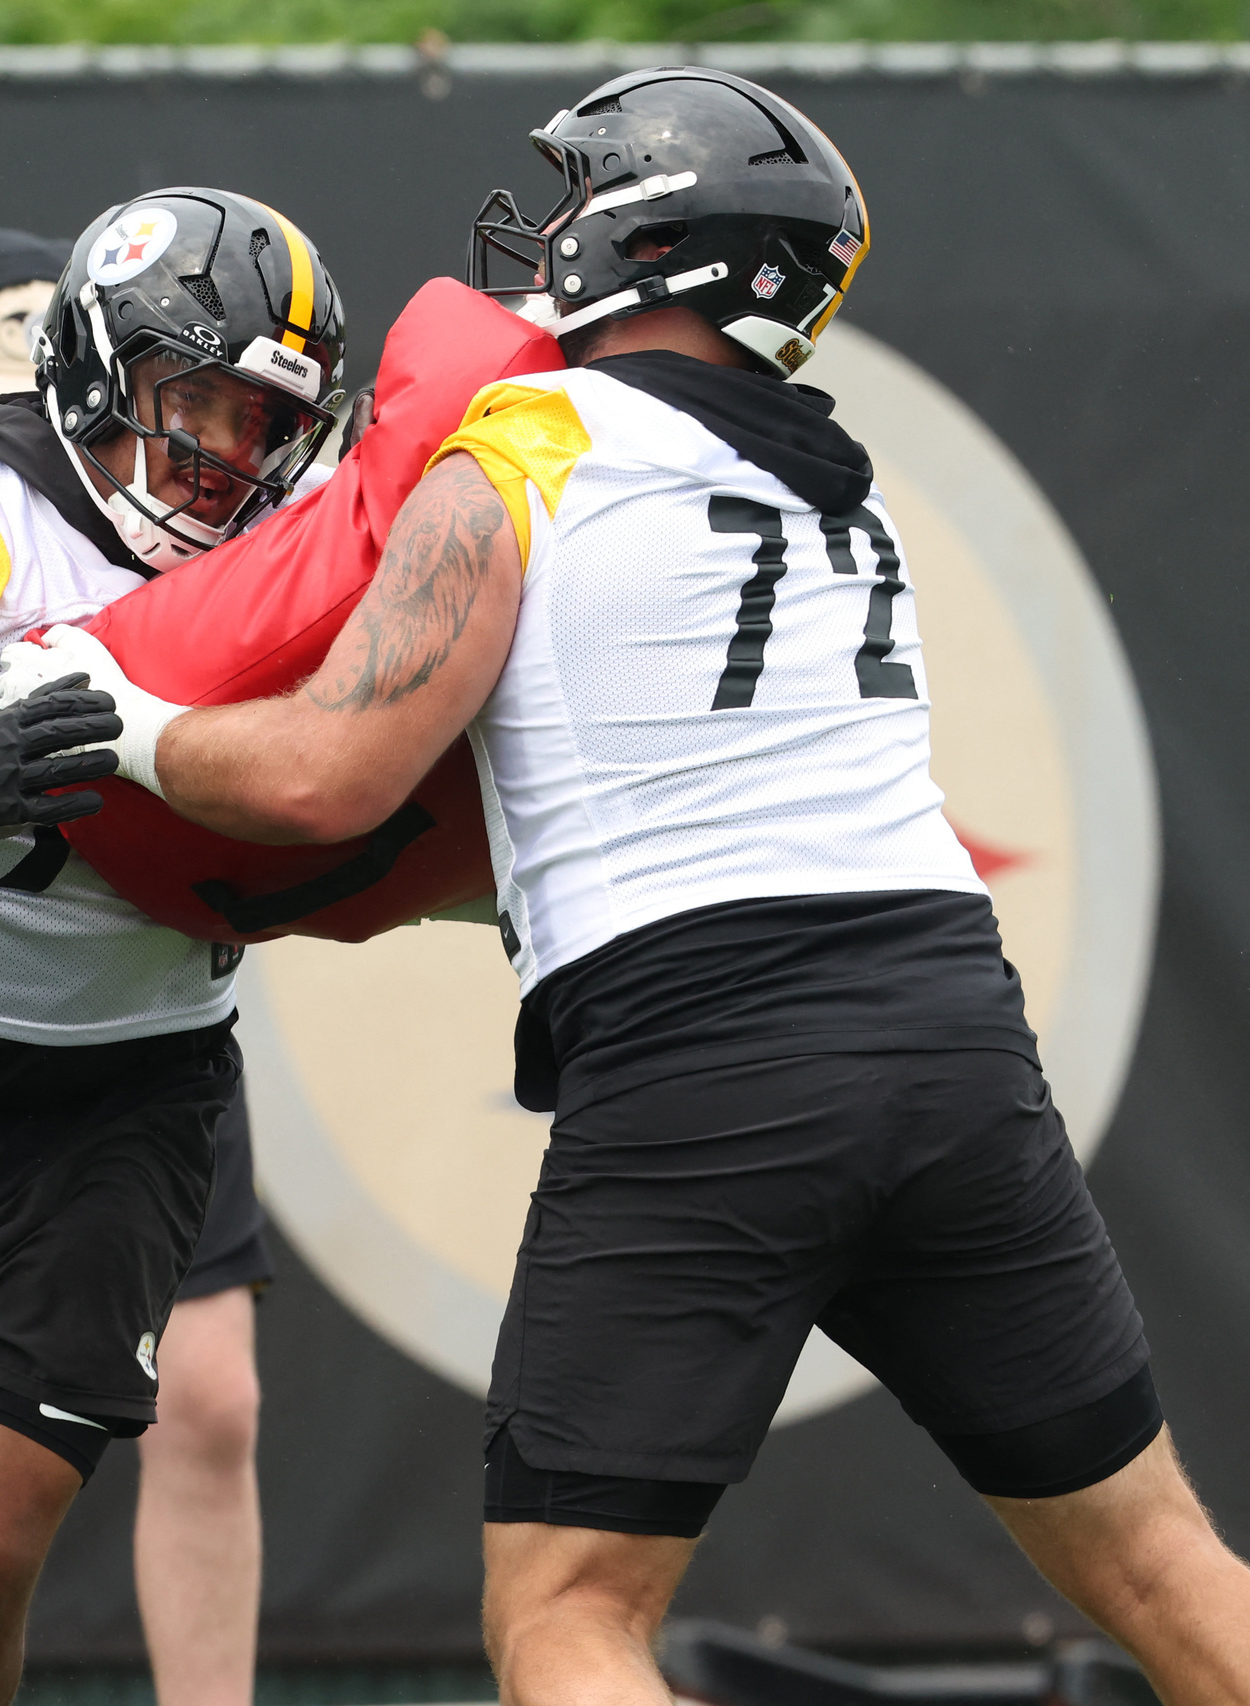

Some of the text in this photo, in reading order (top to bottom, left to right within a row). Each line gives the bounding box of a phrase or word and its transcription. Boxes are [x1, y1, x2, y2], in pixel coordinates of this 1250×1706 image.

[755, 276, 774, 295] NFL
[183, 329, 224, 357] OAKLEY
[270, 349, 309, 379] Steelers
[708, 495, 919, 711] 72
